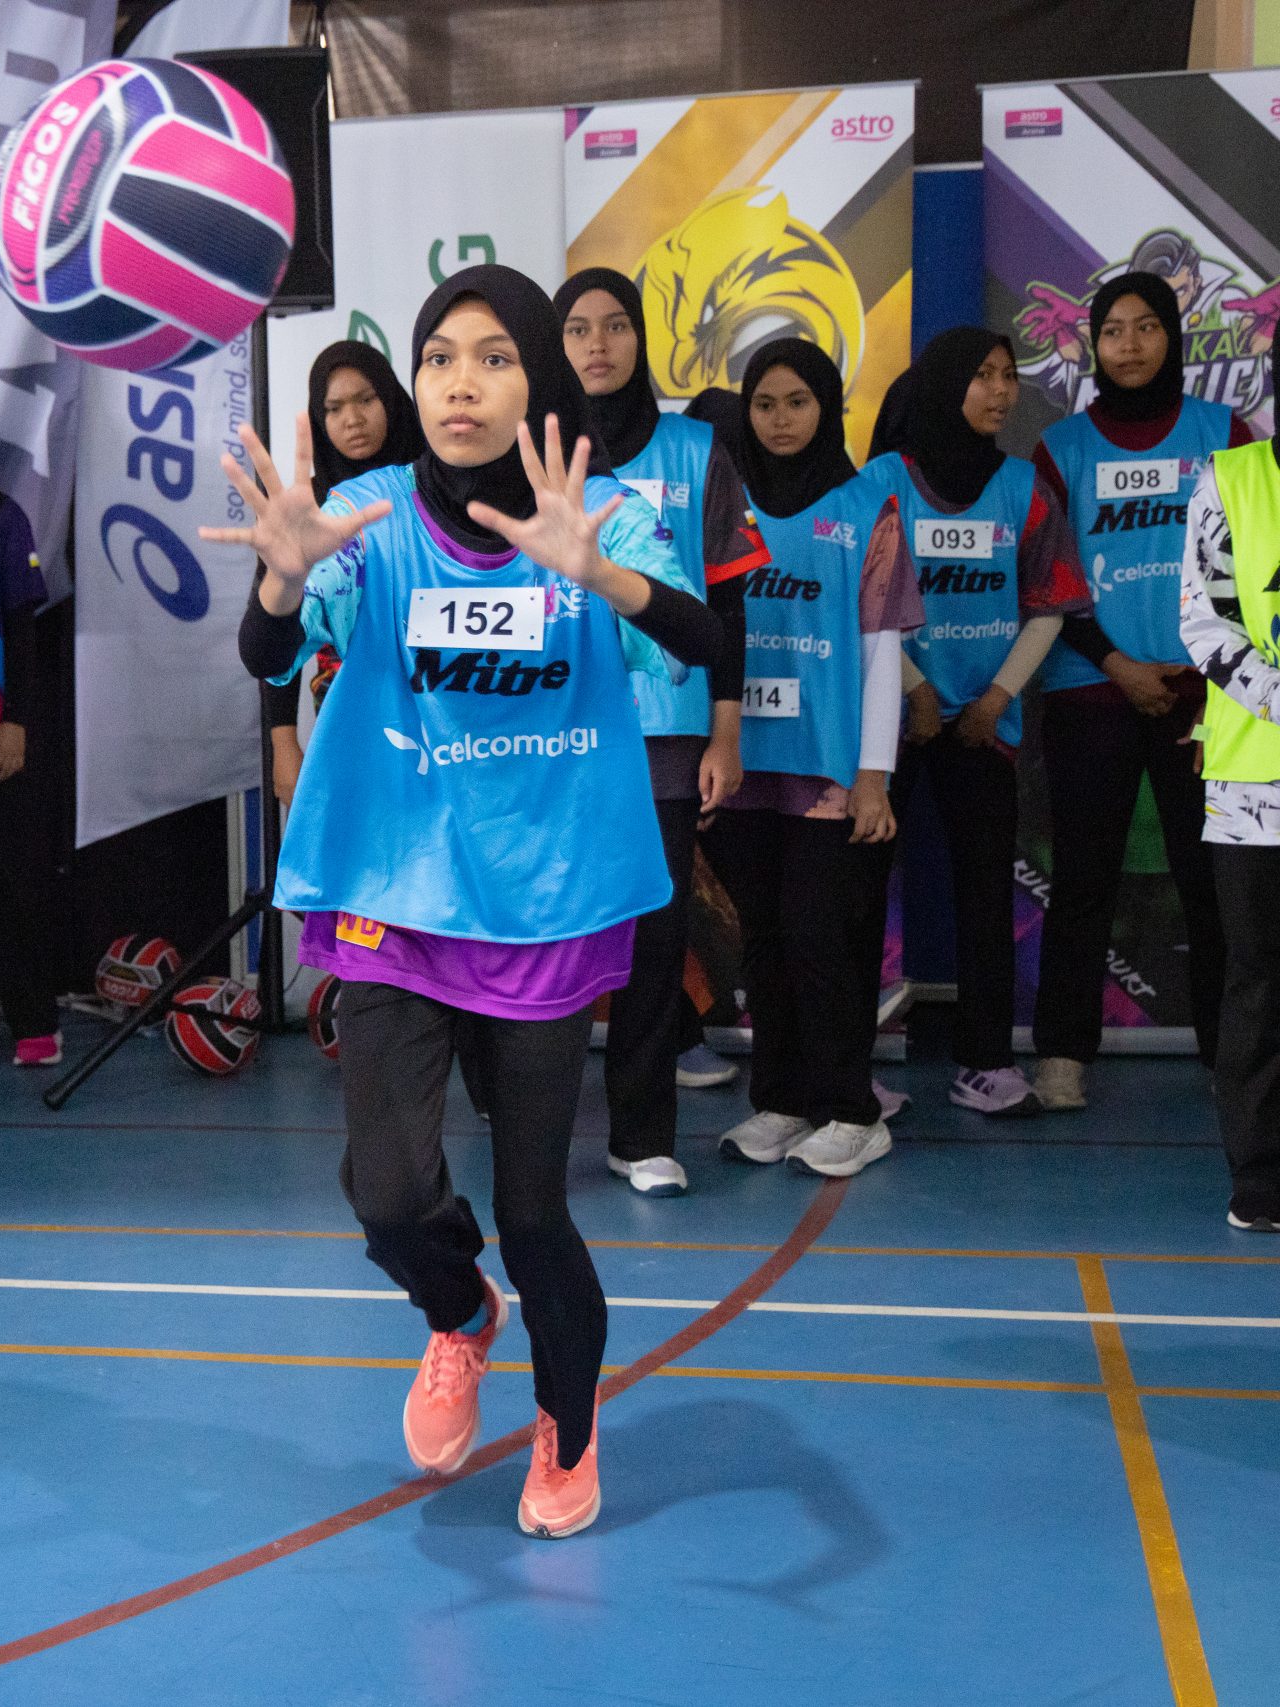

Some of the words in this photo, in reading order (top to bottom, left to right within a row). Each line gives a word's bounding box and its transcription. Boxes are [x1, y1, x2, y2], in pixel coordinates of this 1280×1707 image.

[831, 114, 894, 137] astro
[1114, 468, 1161, 490] 098
[931, 528, 976, 550] 093
[917, 563, 1007, 596] Mitre
[1113, 562, 1182, 583] celcom
[439, 600, 514, 636] 152
[410, 649, 570, 697] Mitre
[744, 686, 782, 709] 114
